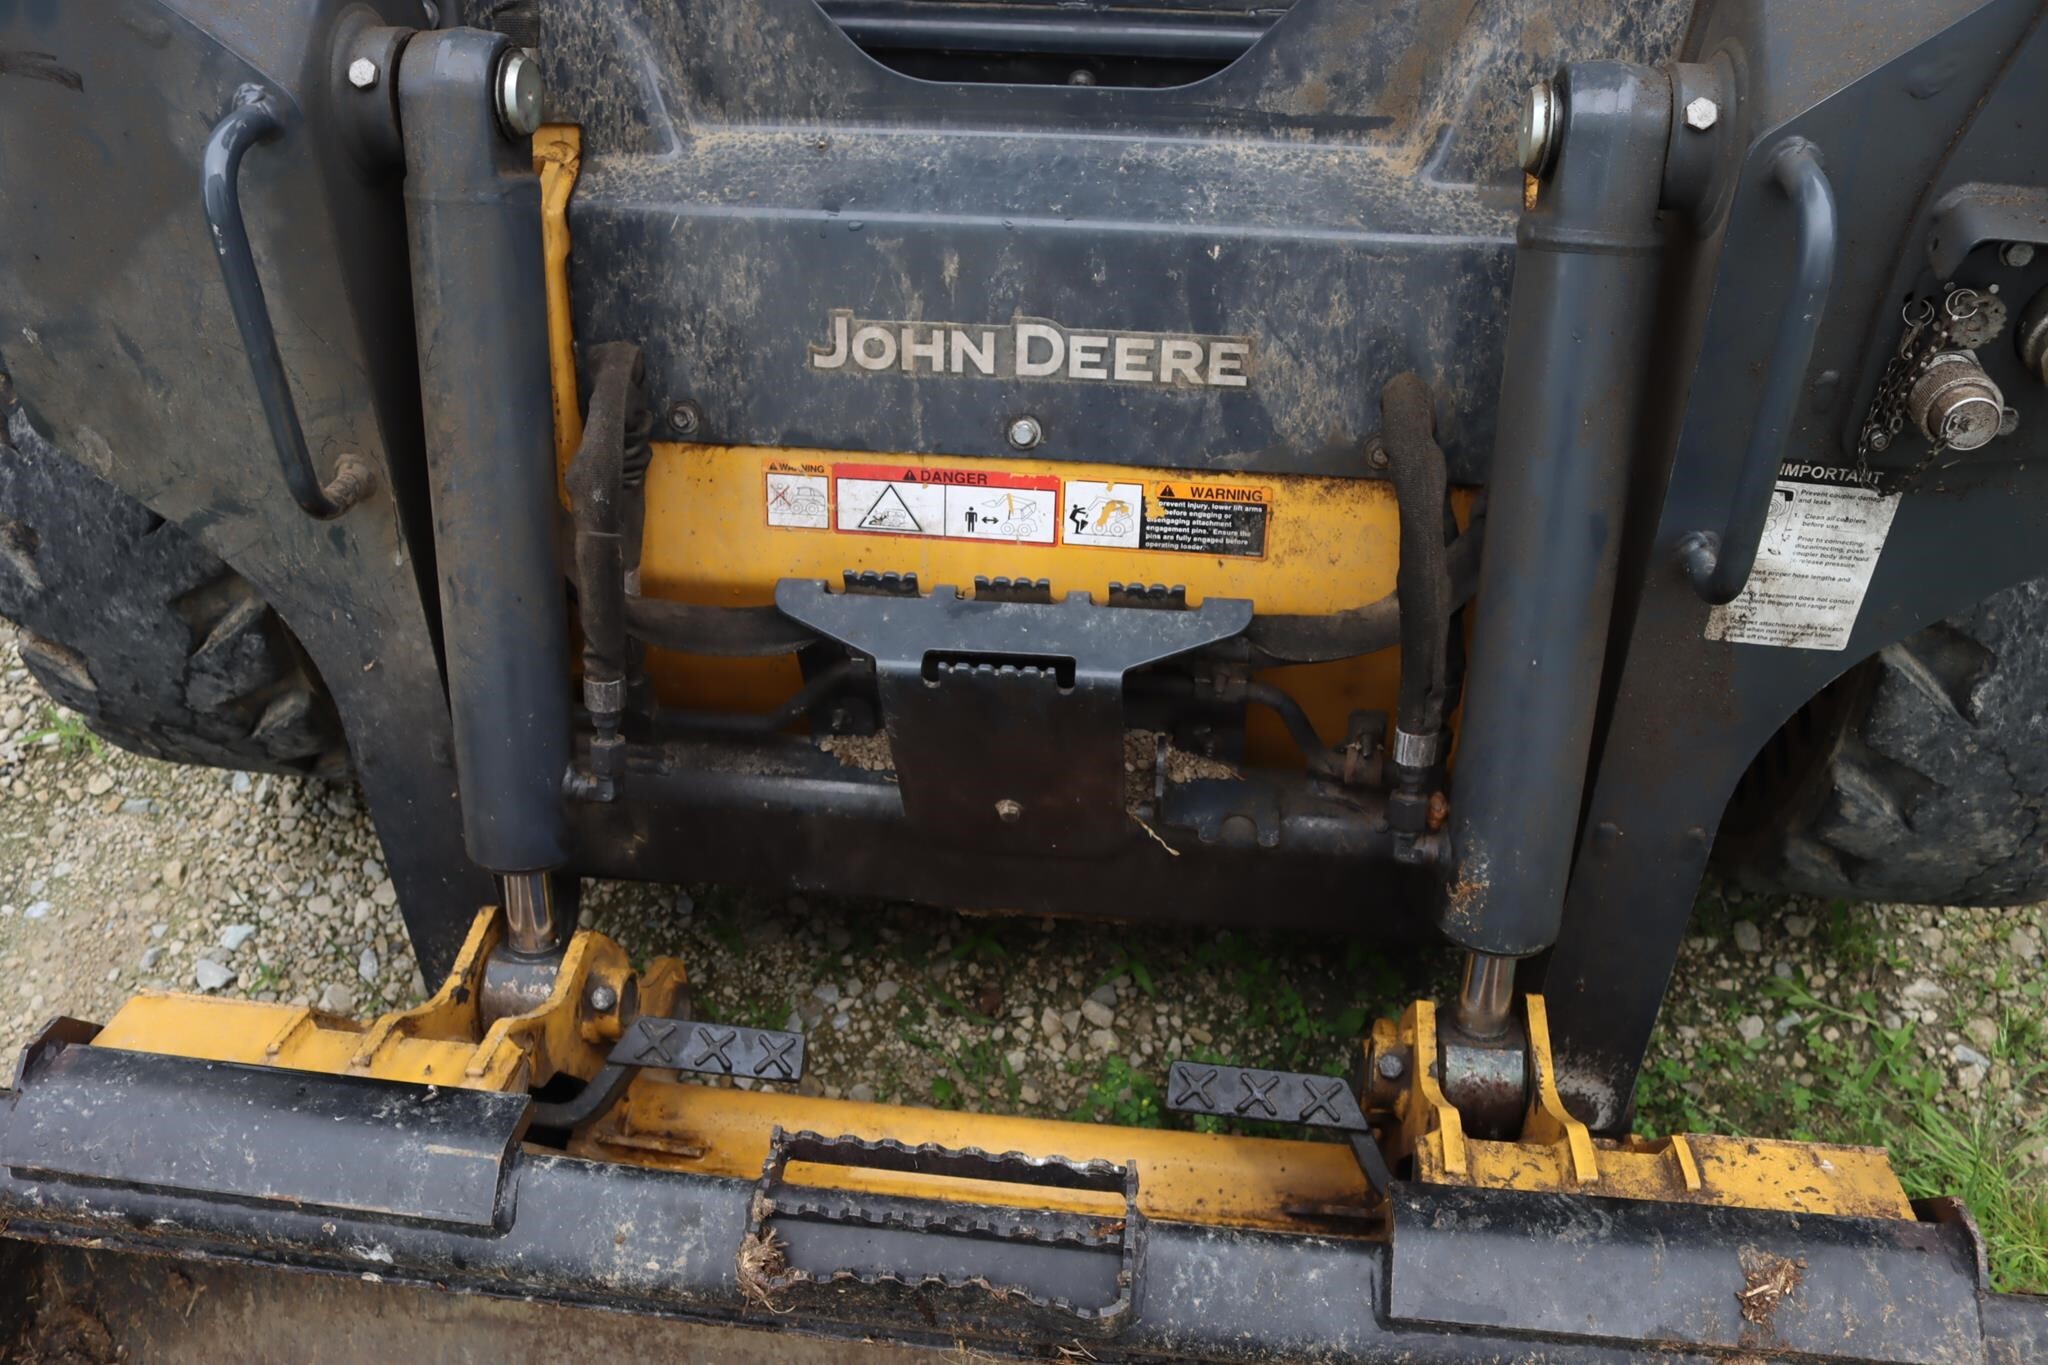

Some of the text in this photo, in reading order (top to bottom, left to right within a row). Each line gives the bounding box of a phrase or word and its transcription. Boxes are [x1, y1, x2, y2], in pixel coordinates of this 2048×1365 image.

[812, 315, 1251, 387] JOHN DEERE
[921, 470, 988, 485] DANGER
[1190, 486, 1263, 502] WARNING
[1800, 489, 1828, 498] Prevent
[1829, 492, 1856, 501] coupler
[1187, 502, 1210, 510] injury,
[1211, 503, 1232, 511] lower
[1233, 504, 1243, 512] lift
[1189, 511, 1222, 520] engaging
[1804, 513, 1825, 521] Clean
[1191, 519, 1232, 528] attachment
[1146, 525, 1251, 538] engagement pins. Ensure the
[1145, 532, 1161, 540] pins
[1175, 534, 1192, 543] fully
[1193, 536, 1224, 545] engaged
[1225, 537, 1249, 546] before
[1145, 541, 1206, 551] operating loader.
[1820, 552, 1838, 561] body
